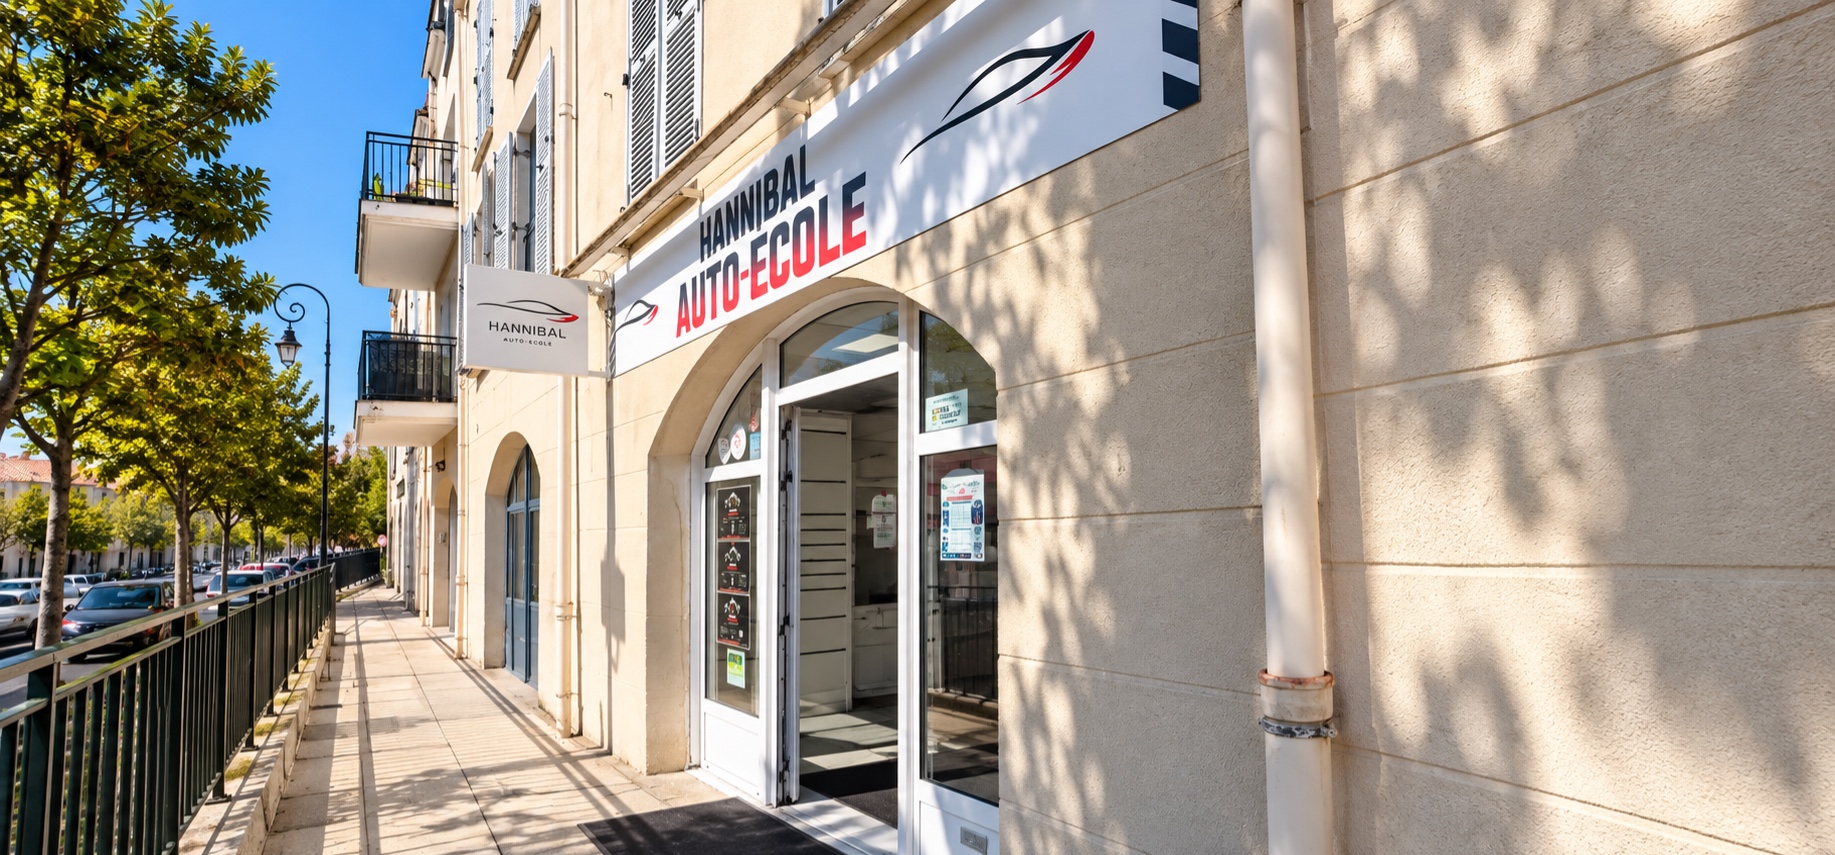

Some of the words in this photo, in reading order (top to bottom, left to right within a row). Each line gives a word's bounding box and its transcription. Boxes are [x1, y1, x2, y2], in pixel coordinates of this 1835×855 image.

[676, 171, 867, 339] AUTO-ECOLE
[700, 144, 816, 264] HANNIBAL
[489, 320, 567, 339] HANNIBAL
